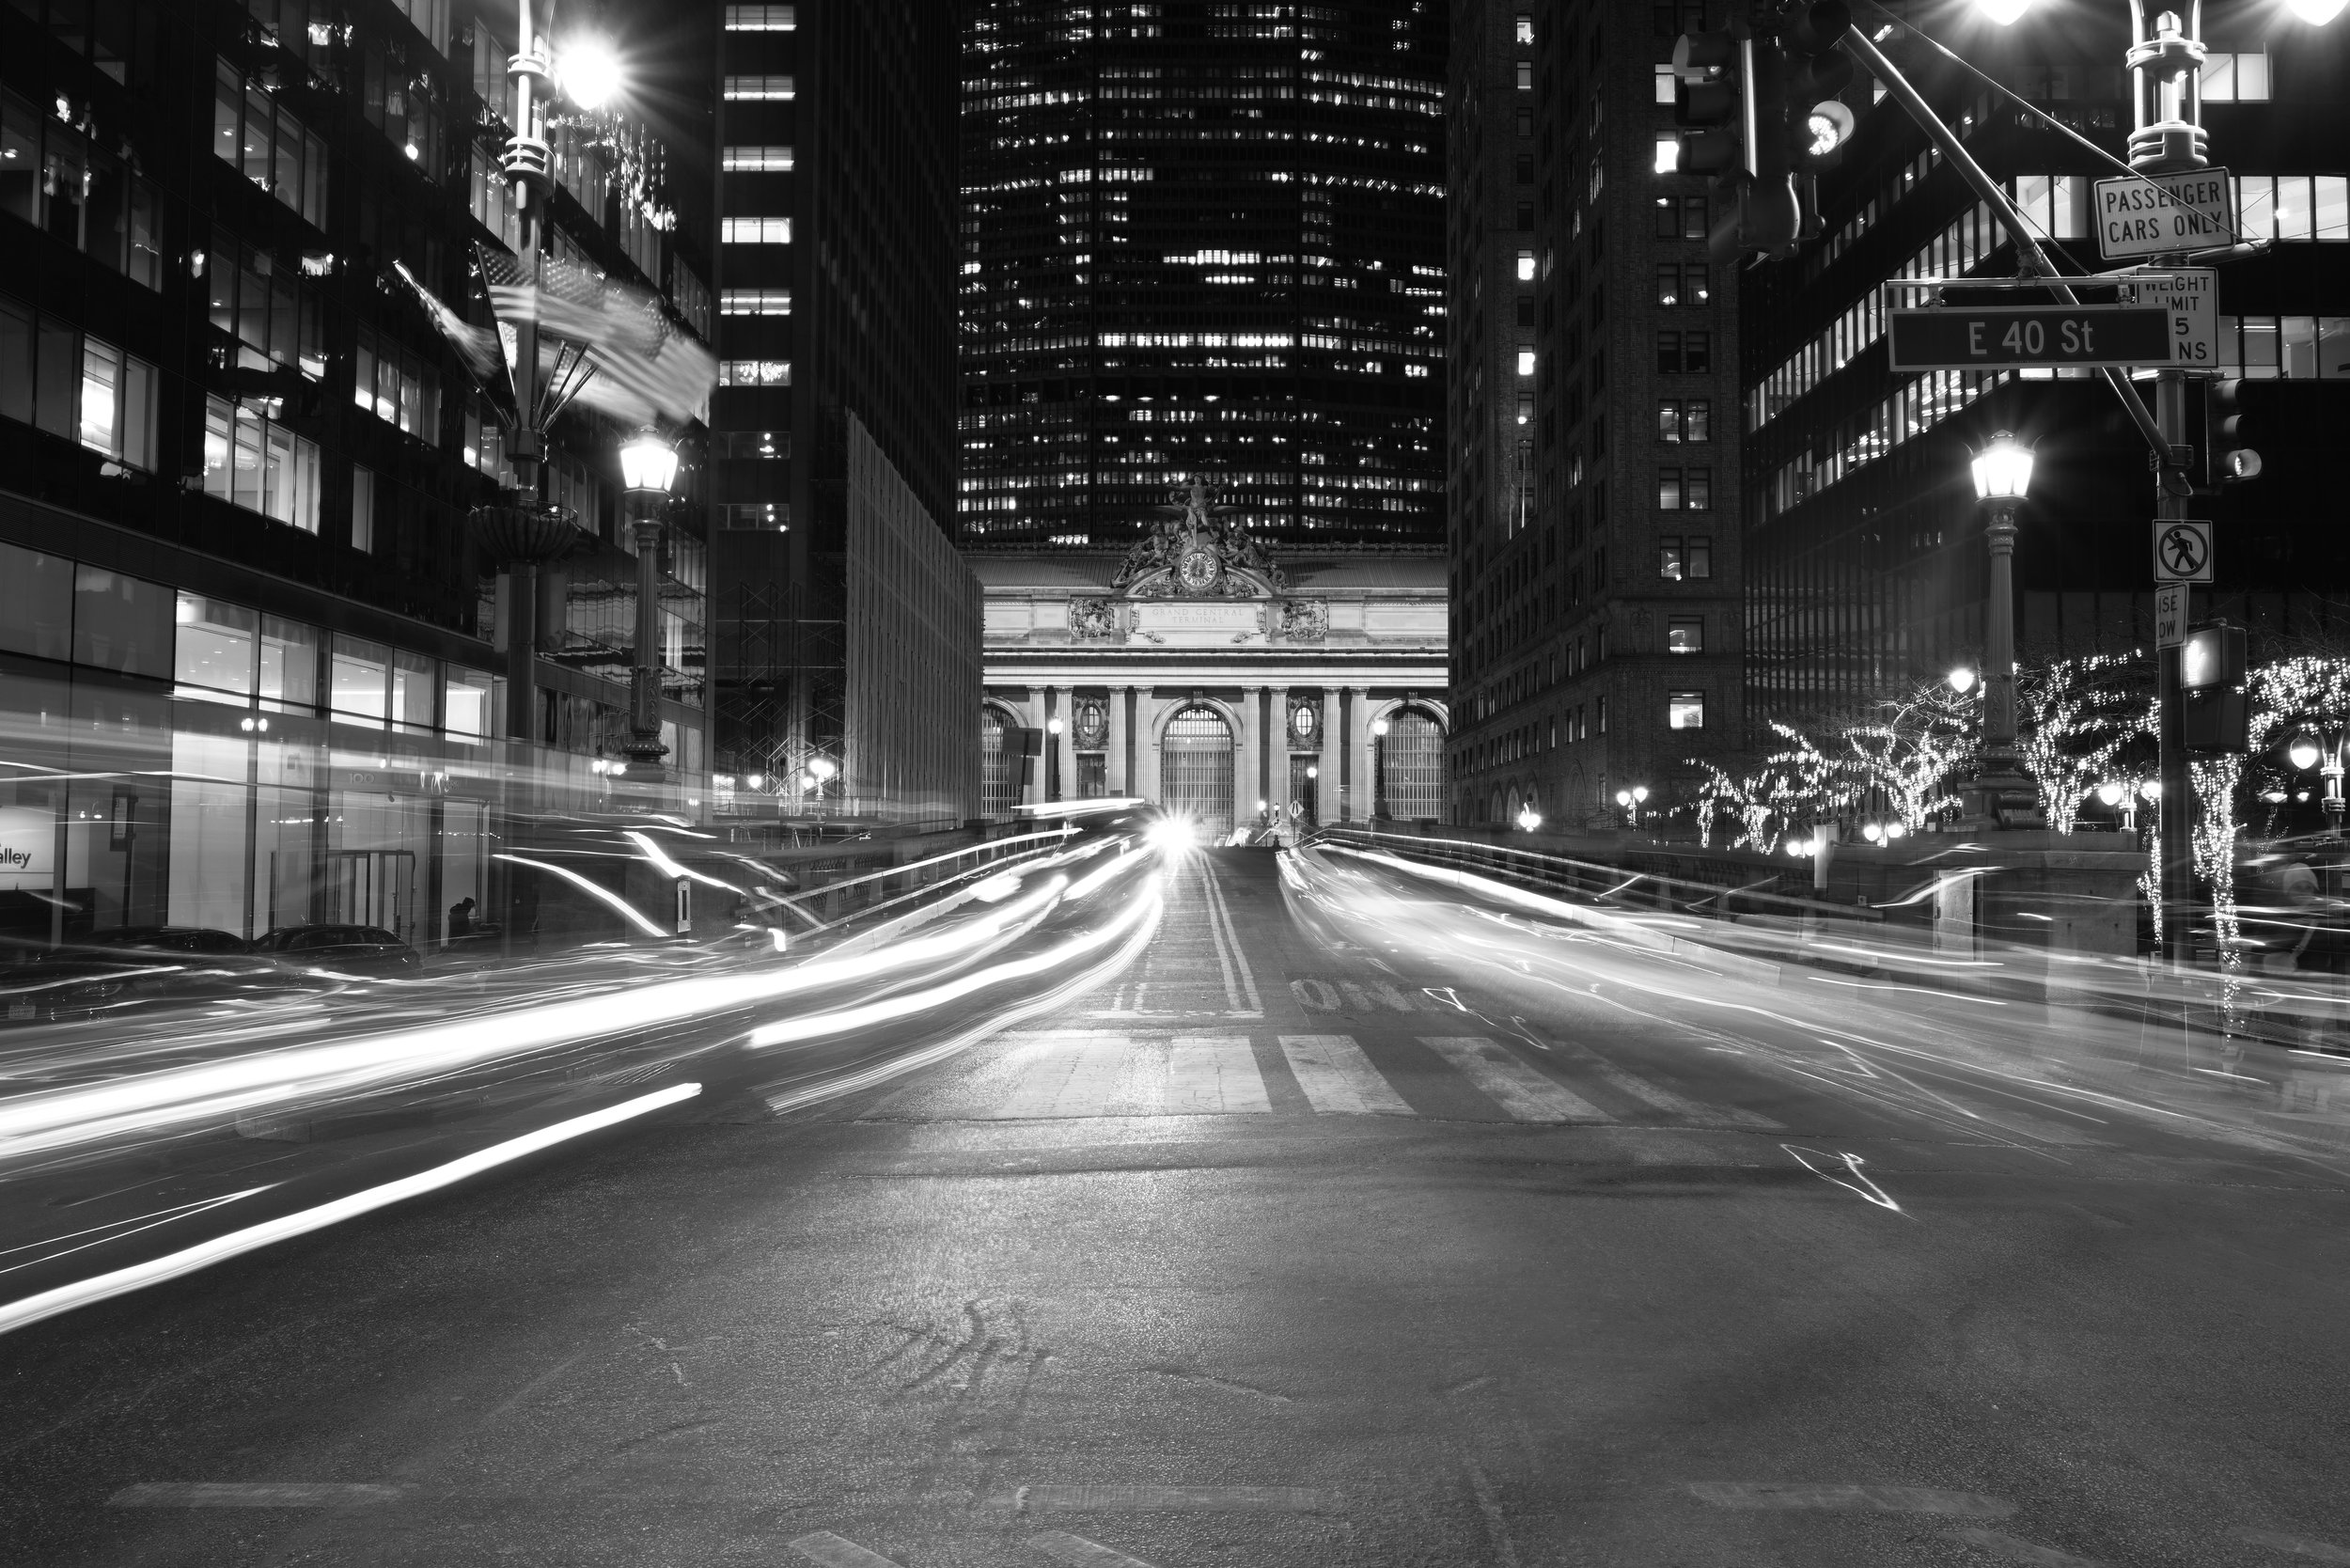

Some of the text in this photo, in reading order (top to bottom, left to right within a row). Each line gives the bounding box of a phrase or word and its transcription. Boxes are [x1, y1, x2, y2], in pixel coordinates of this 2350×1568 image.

[2106, 180, 2220, 213] PASSENGER
[2108, 211, 2222, 243] CARS ONLY
[1968, 319, 2094, 355] E 40 St
[1151, 608, 1244, 617] GRAND CENTRAL
[1171, 616, 1224, 624] TERMINAL
